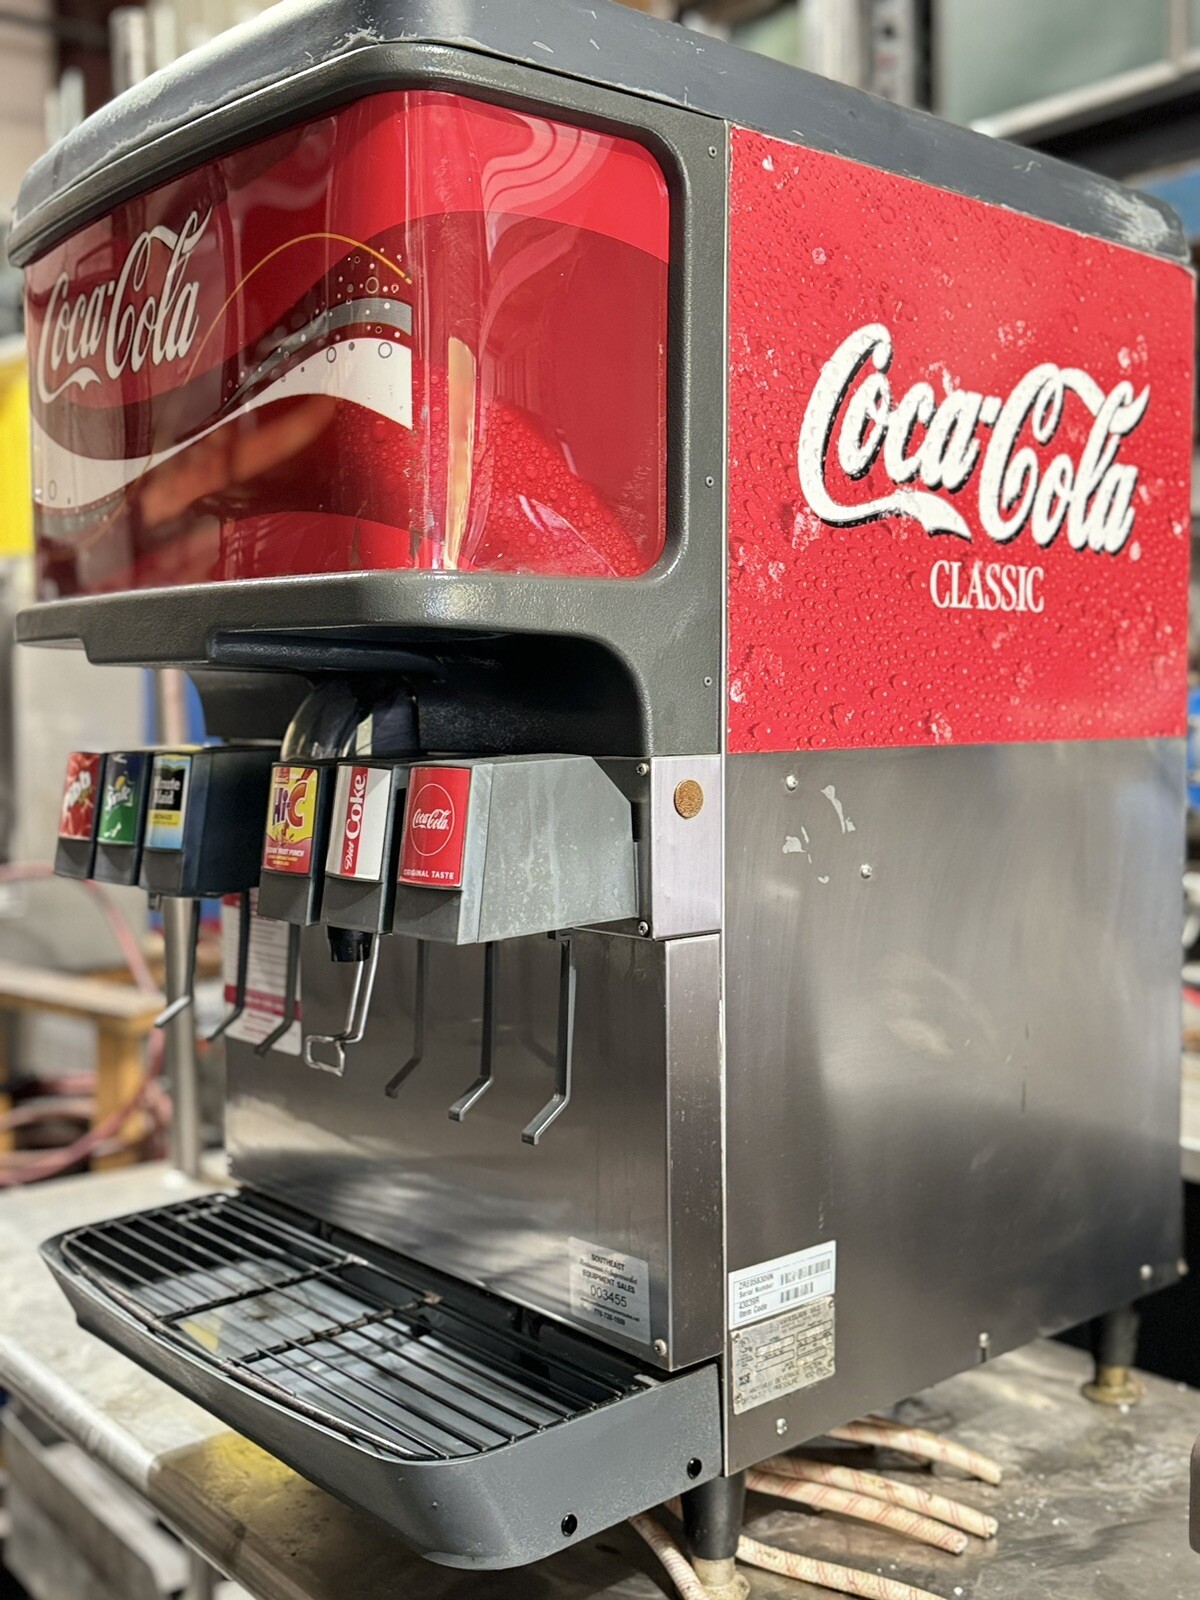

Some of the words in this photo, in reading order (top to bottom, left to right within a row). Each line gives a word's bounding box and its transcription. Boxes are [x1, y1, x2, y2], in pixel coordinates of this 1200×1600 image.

[37, 204, 213, 404] Coca-Cola
[798, 322, 1151, 558] Coca-Cola
[930, 559, 1046, 613] CLASSIC
[346, 775, 366, 839] Coke
[344, 842, 355, 870] Diet
[431, 870, 454, 880] TASTE
[590, 1284, 627, 1308] 003455
[616, 1281, 635, 1294] SALES
[753, 1302, 768, 1314] Code
